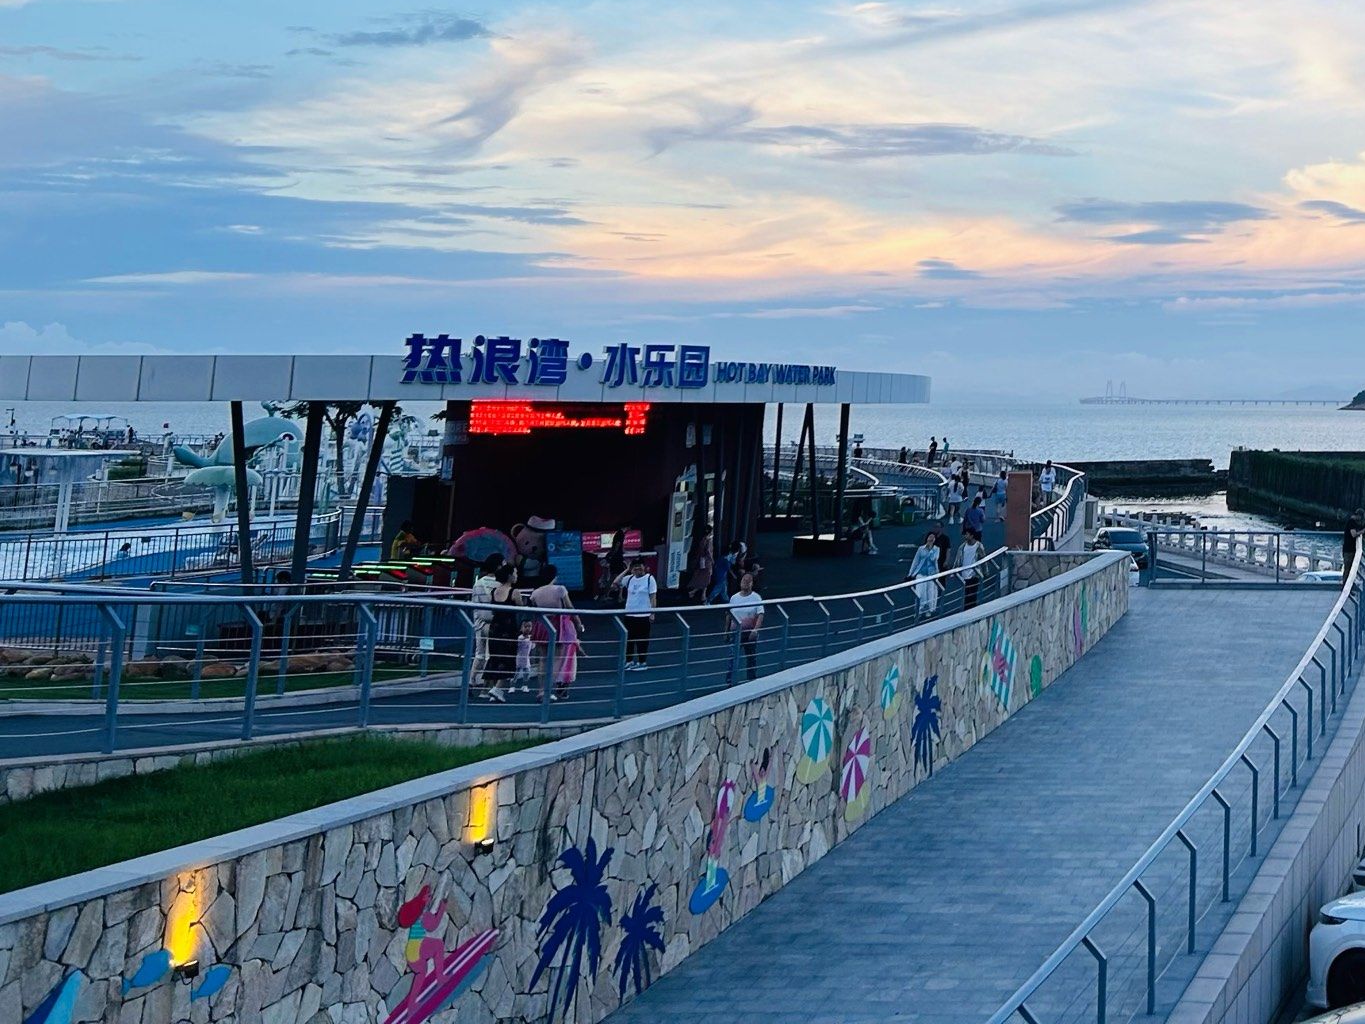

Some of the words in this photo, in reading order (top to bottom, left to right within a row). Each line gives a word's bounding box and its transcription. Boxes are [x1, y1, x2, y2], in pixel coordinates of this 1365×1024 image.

[712, 361, 746, 384] HOT
[745, 362, 773, 384] BAY
[772, 363, 811, 385] WATER
[811, 365, 837, 386] PARK
